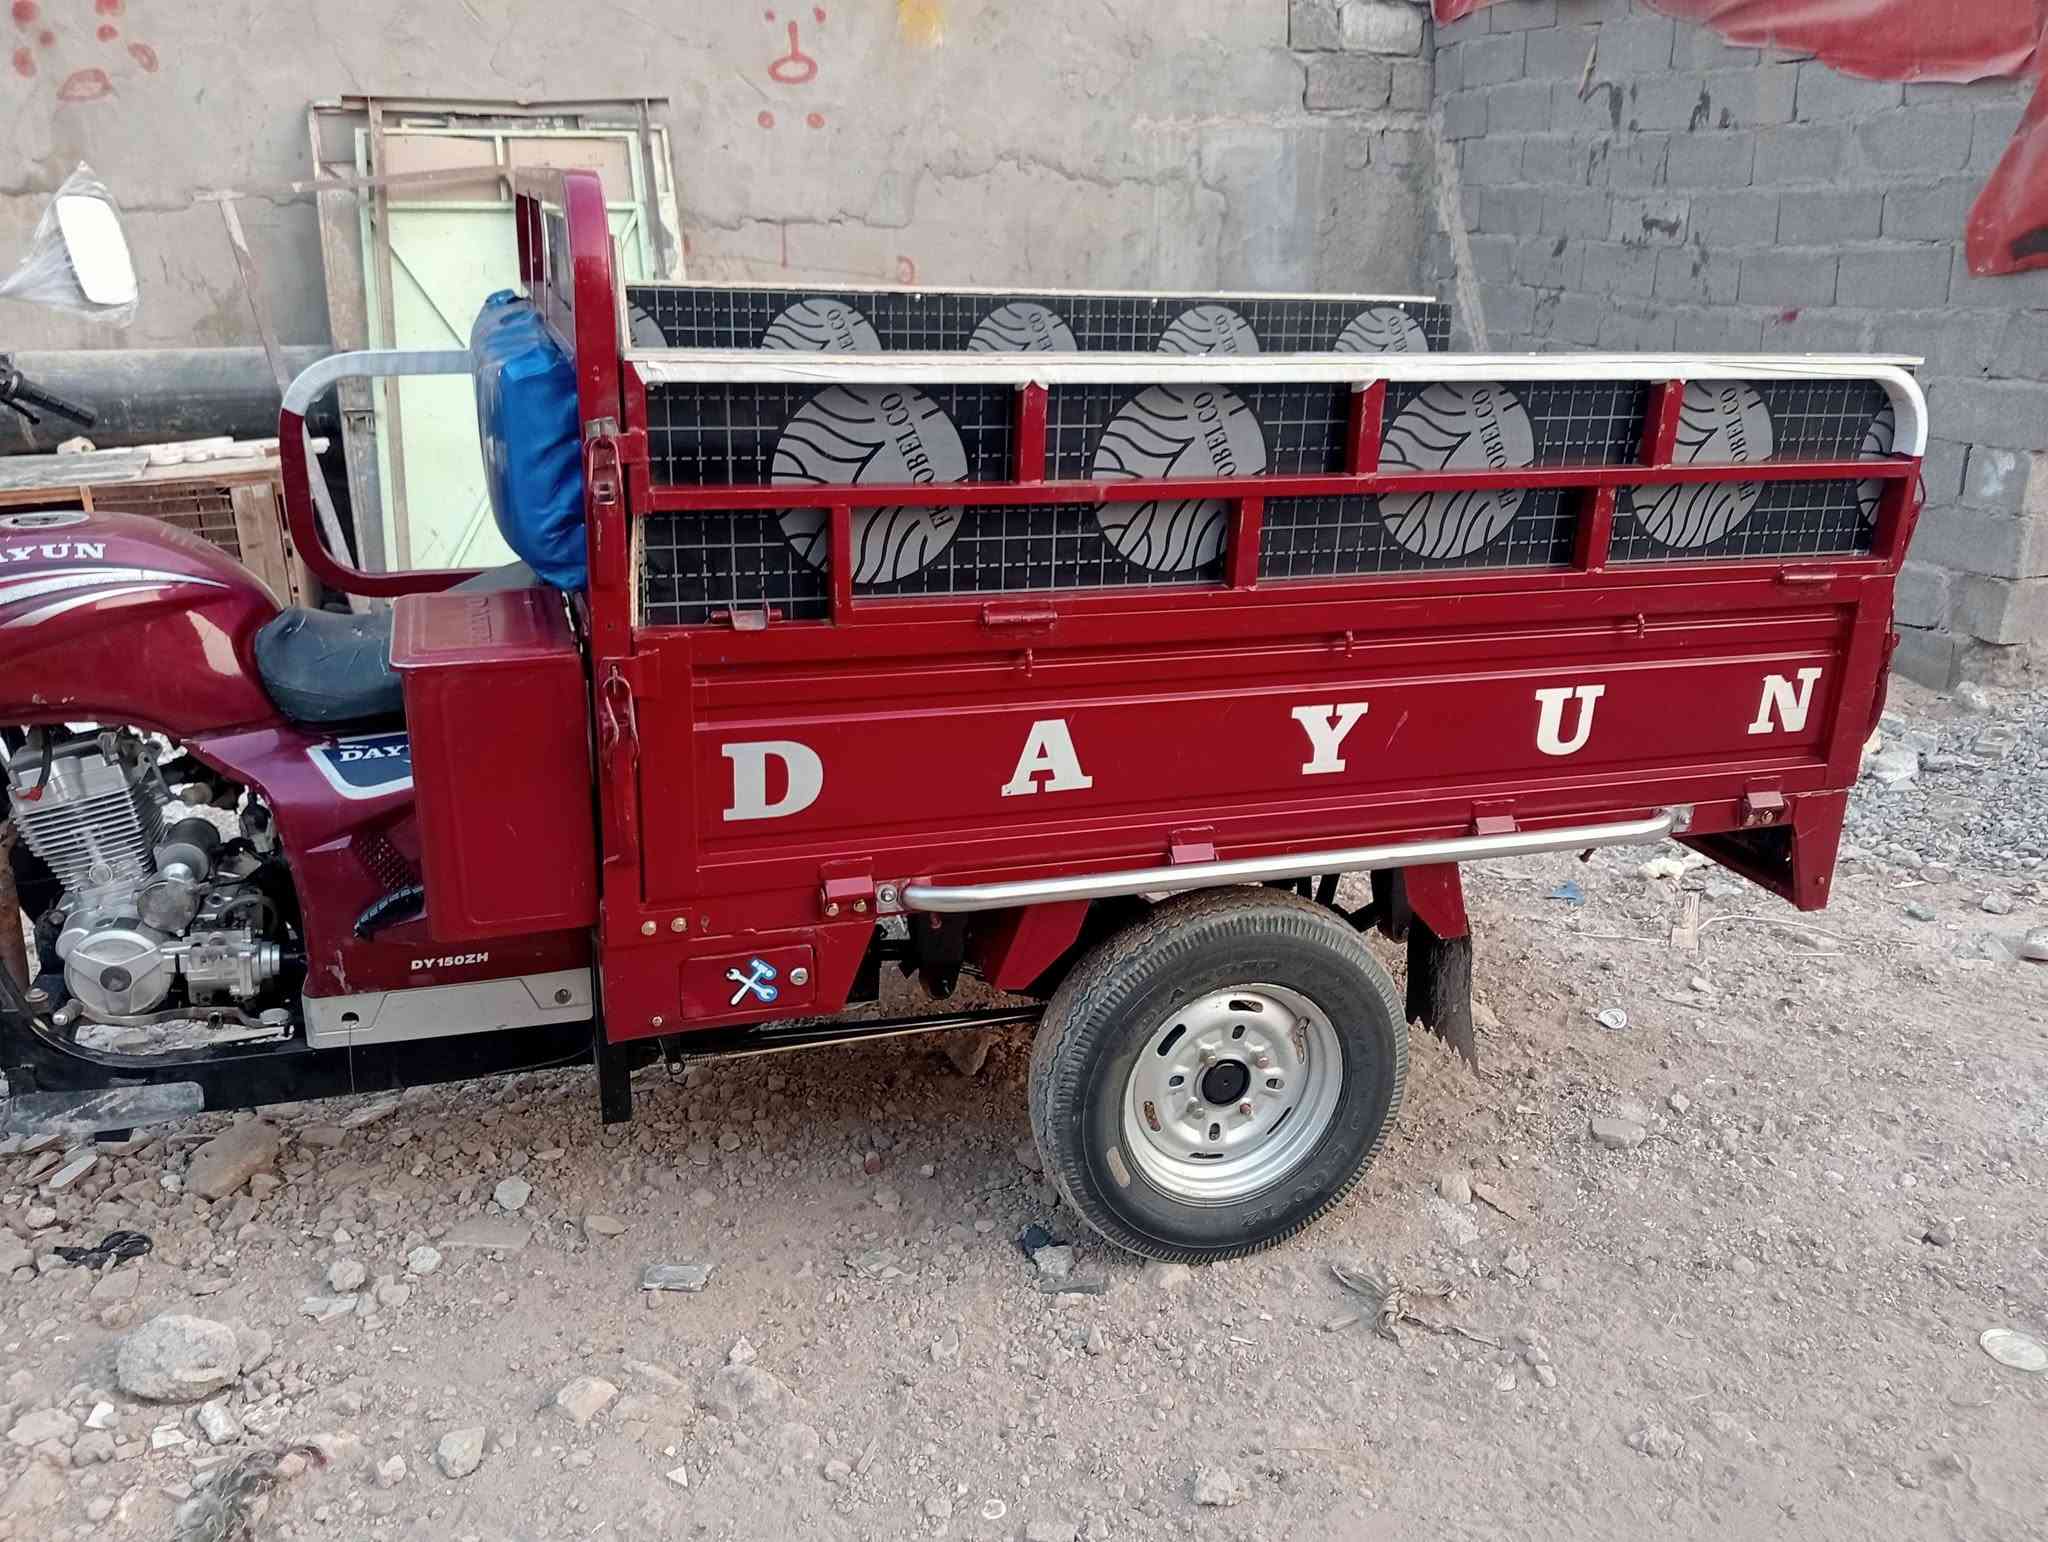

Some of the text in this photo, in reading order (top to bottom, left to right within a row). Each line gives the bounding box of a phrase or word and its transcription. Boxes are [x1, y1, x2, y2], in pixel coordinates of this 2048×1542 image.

[0, 543, 106, 563] YUN
[340, 745, 411, 762] DAY
[410, 951, 489, 971] DY150ZH
